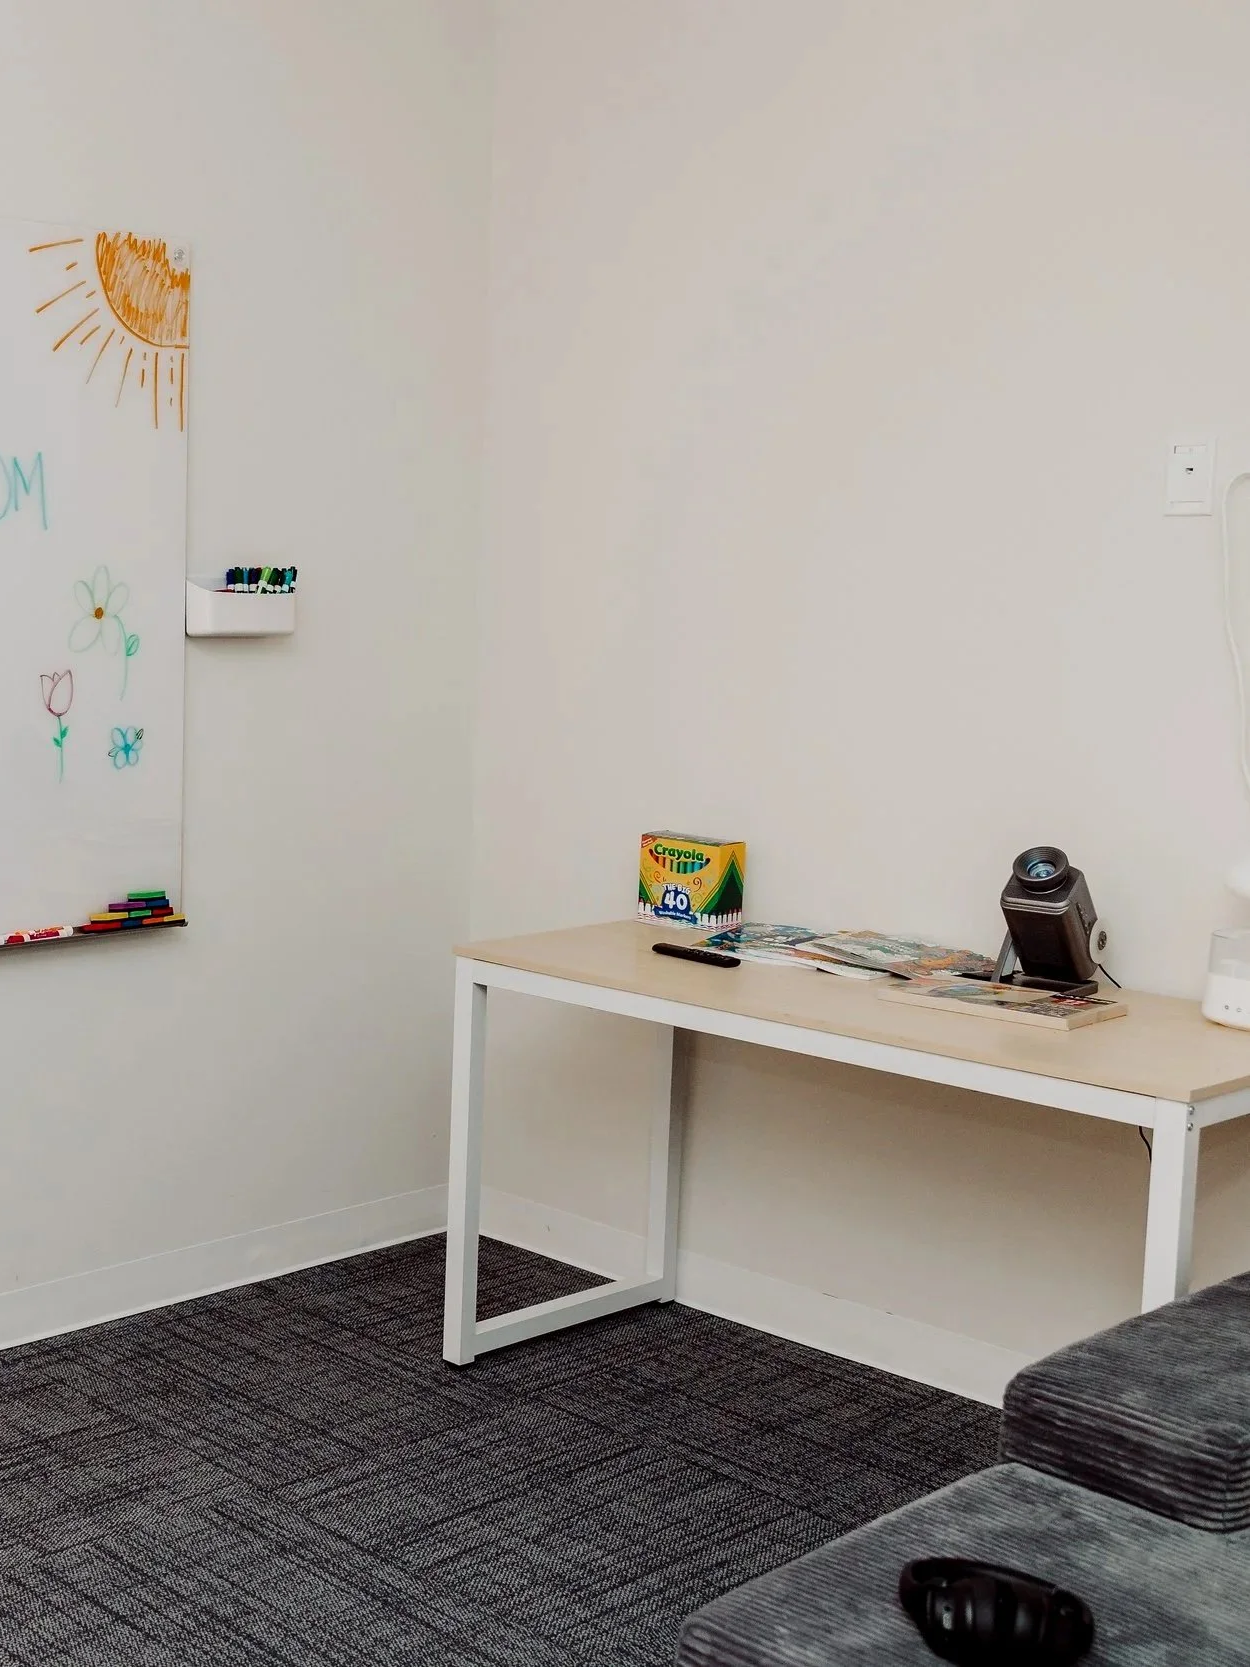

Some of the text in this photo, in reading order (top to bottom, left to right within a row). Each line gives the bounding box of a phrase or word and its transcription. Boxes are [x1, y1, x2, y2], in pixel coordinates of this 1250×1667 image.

[653, 843, 704, 861] Crayola
[662, 883, 691, 895] THE BIG
[664, 891, 688, 910] 40
